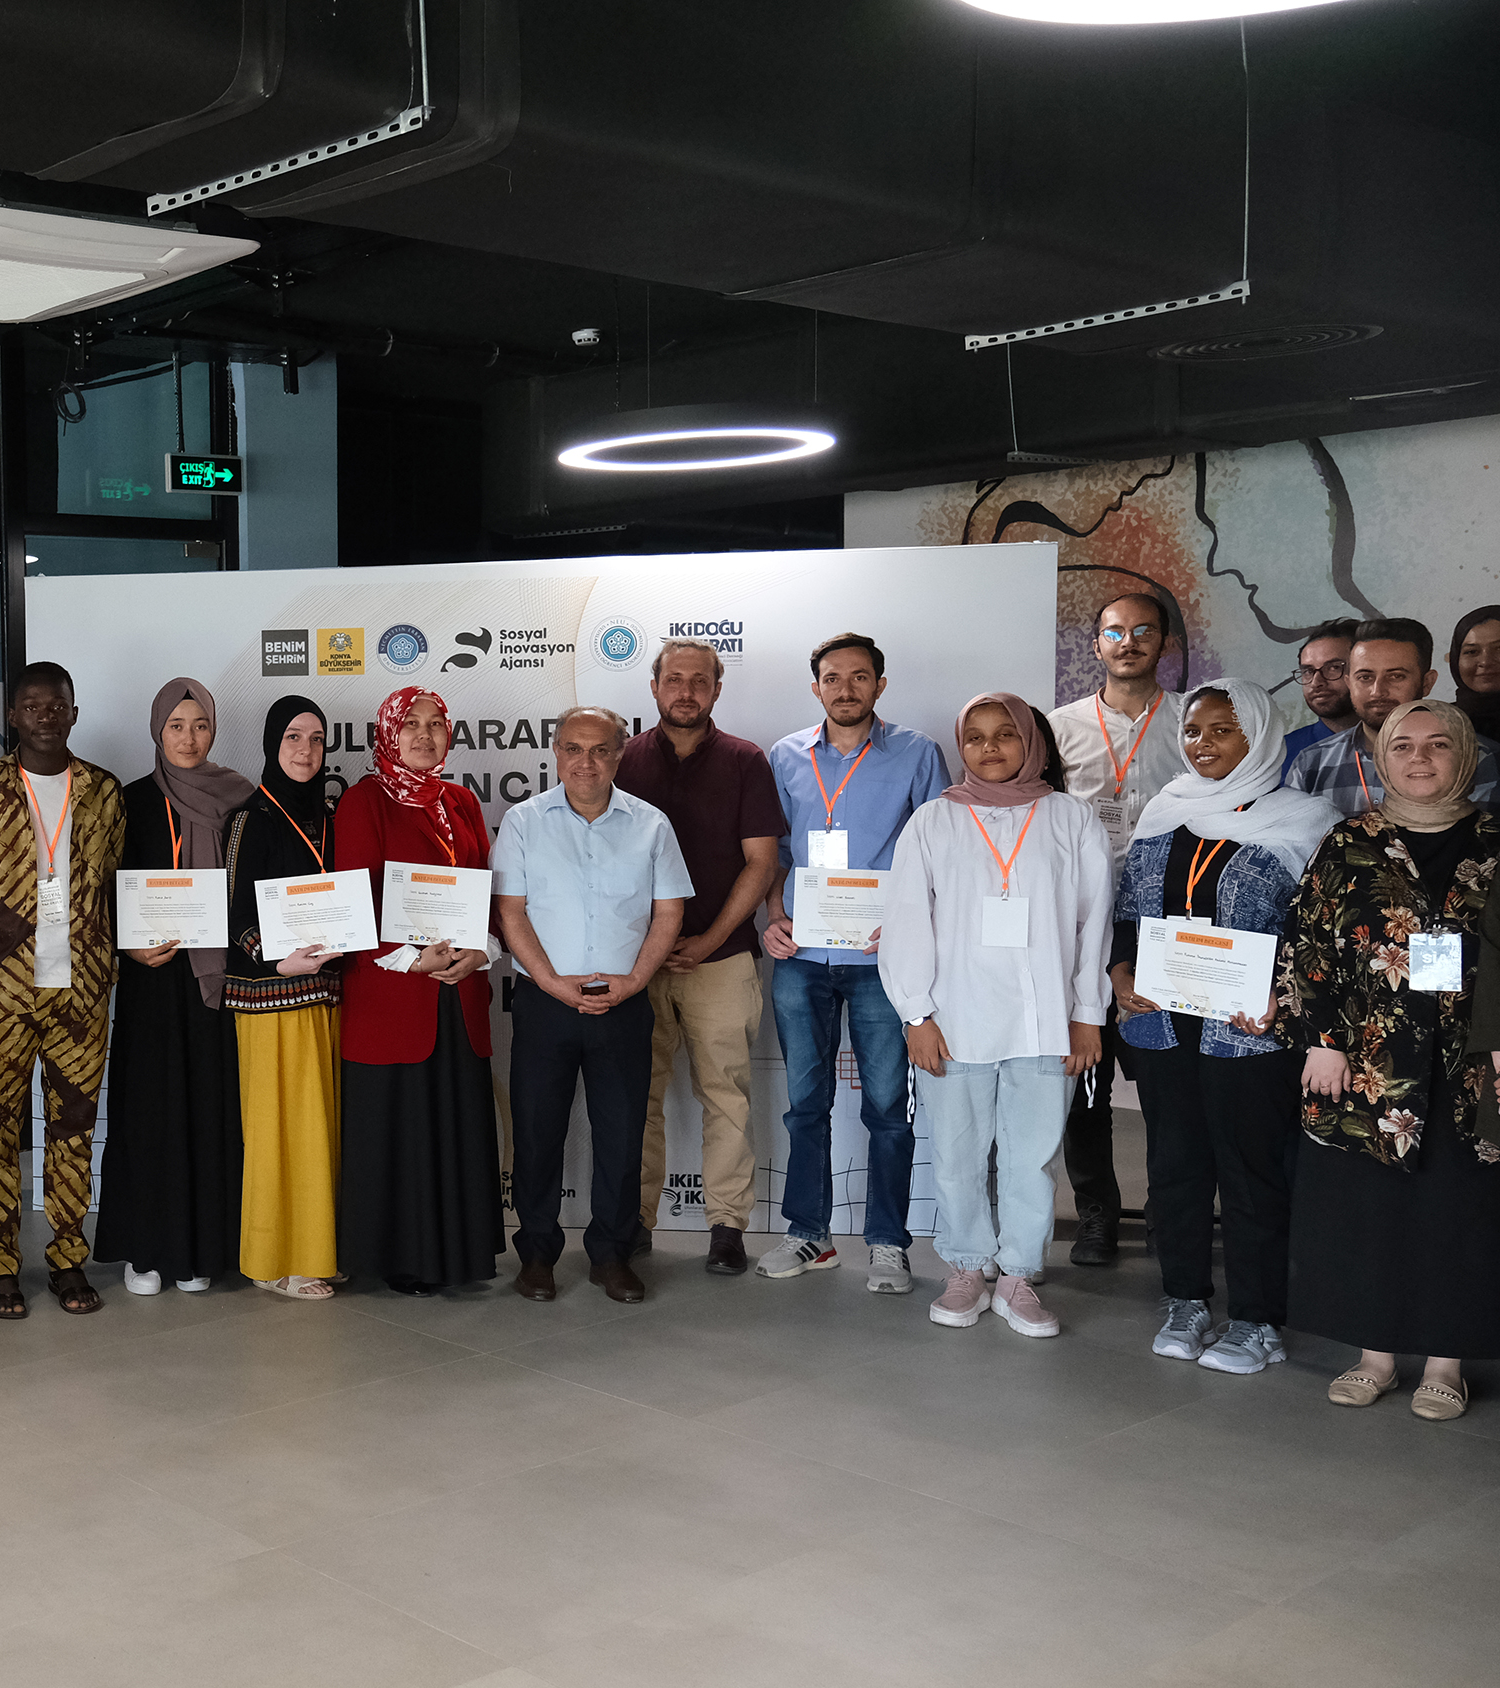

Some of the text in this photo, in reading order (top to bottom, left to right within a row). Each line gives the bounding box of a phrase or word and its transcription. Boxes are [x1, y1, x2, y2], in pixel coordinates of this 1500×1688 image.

[180, 463, 204, 474] ÇIKIŞ
[182, 475, 202, 484] EXIT
[500, 628, 547, 642] Sosyal
[500, 658, 544, 671] Ajansı
